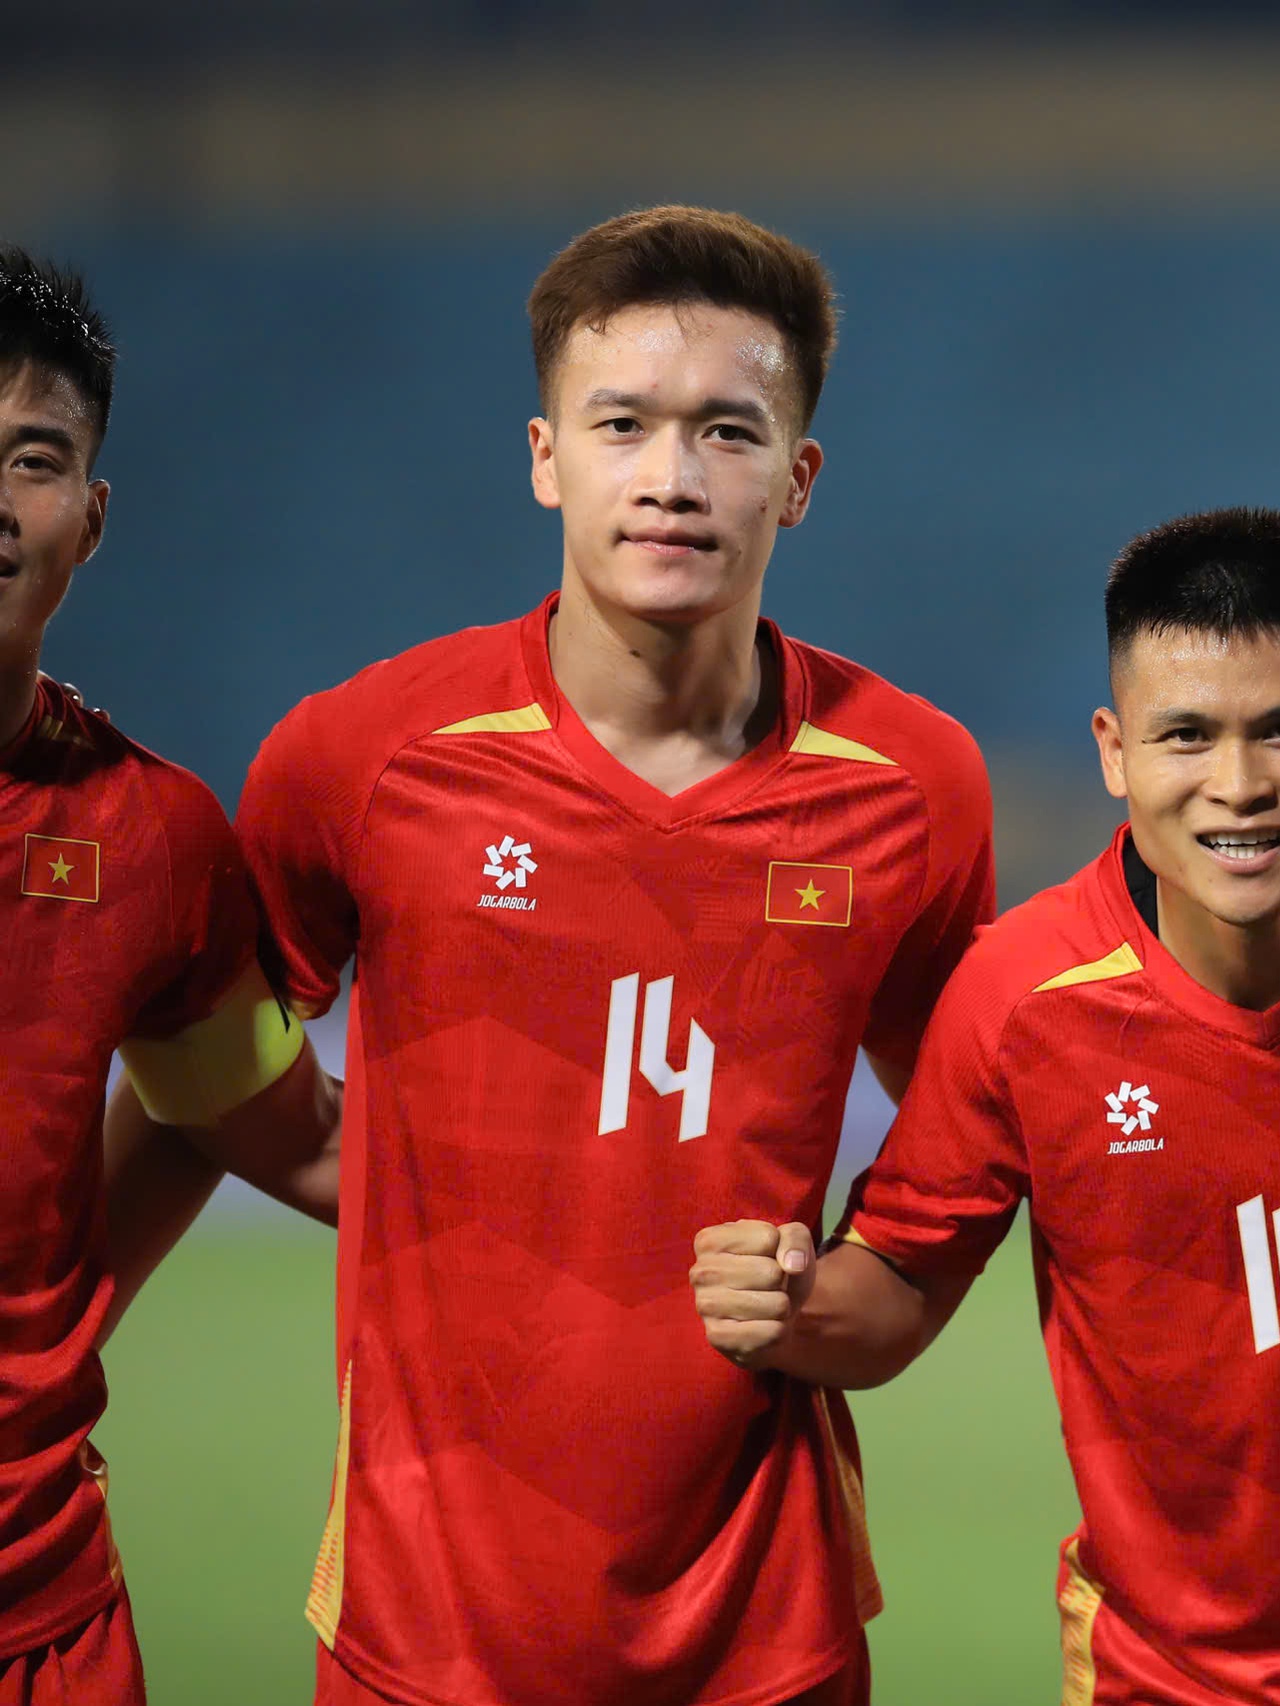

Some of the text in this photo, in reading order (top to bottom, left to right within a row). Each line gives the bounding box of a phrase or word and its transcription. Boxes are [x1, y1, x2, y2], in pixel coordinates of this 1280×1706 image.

[477, 894, 537, 912] JOGARBOLA
[597, 971, 716, 1143] 14
[1107, 1137, 1164, 1155] JOGARBOLA
